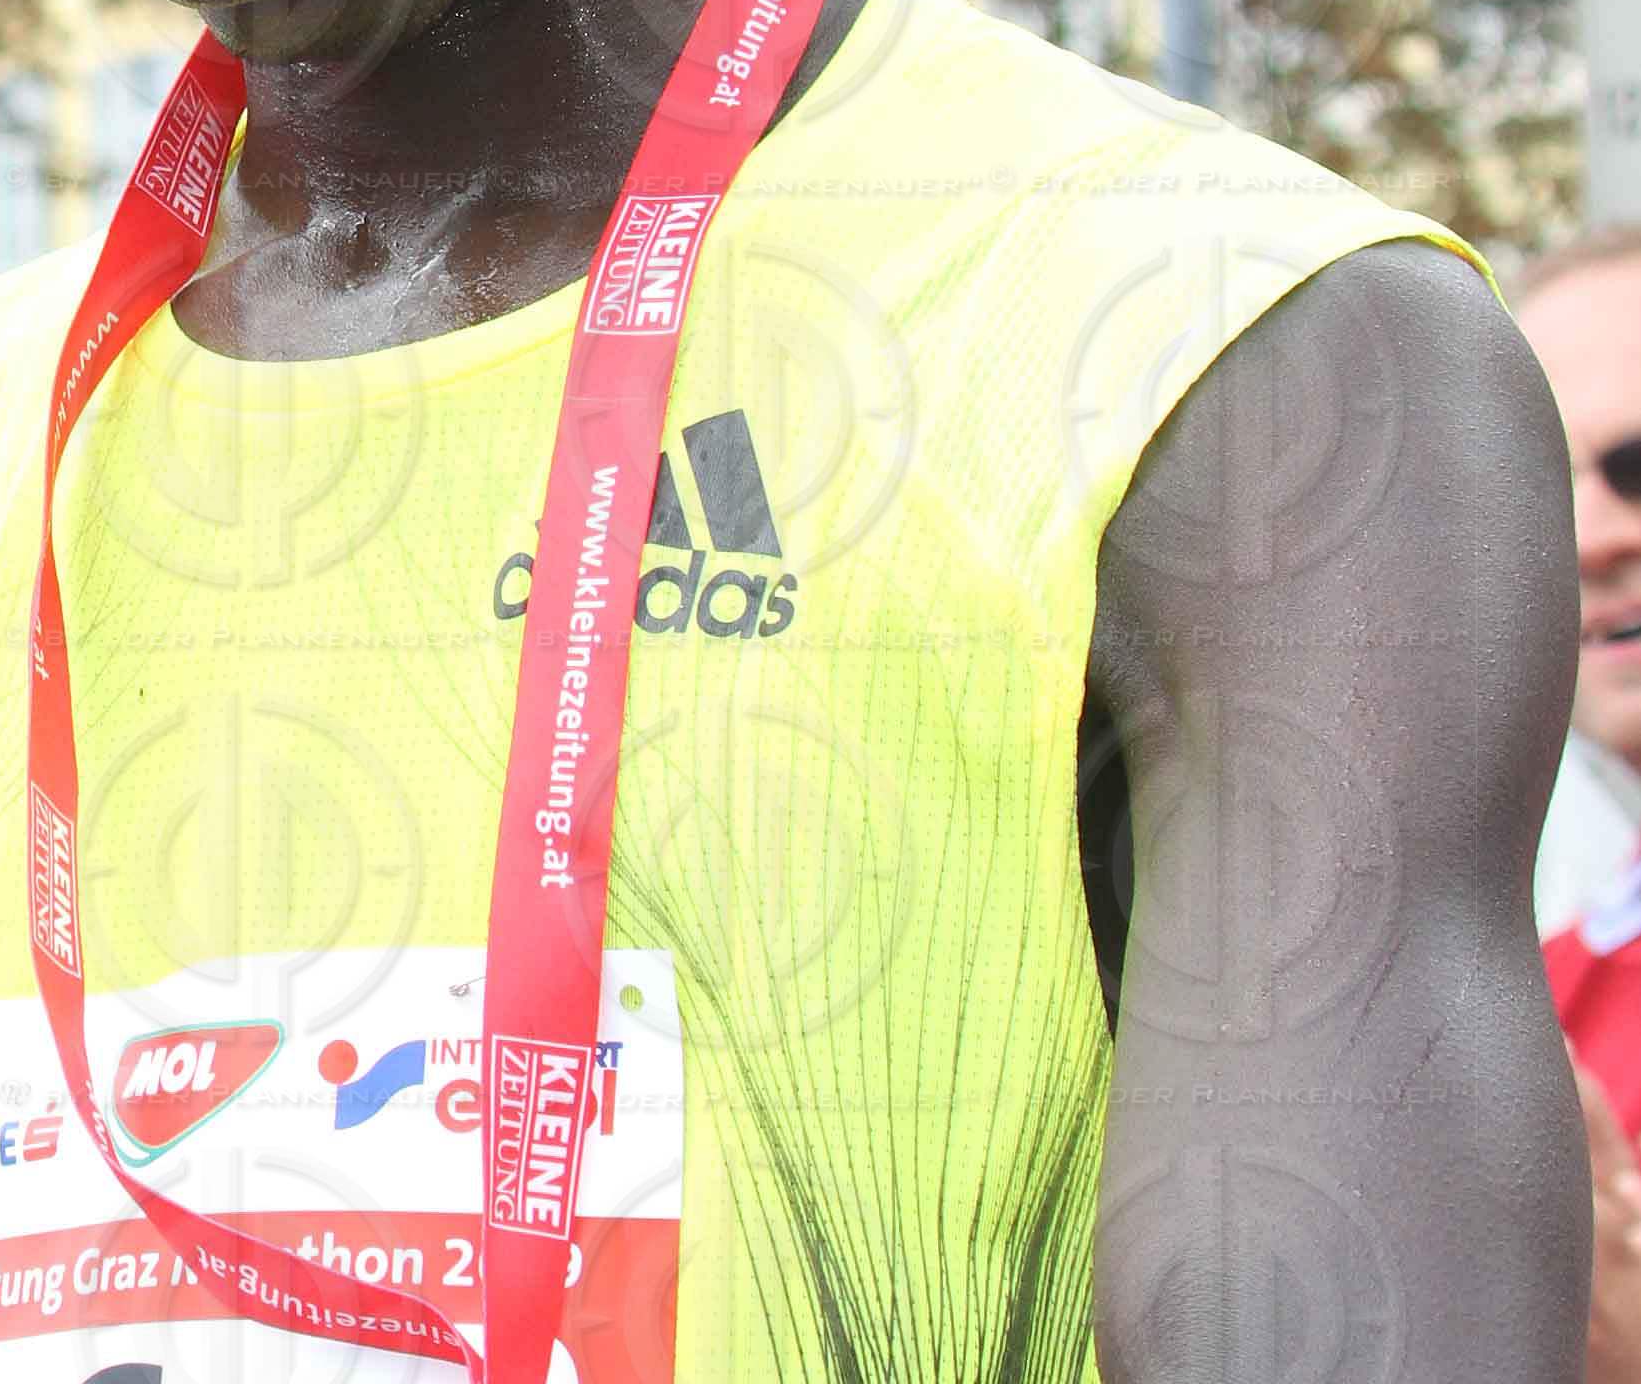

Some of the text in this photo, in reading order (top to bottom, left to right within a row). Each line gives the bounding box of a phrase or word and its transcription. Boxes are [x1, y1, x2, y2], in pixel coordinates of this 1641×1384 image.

[143, 83, 201, 195] ZEITUNG
[172, 111, 223, 225] KLEINE
[597, 203, 660, 327] ZEITUNG
[635, 201, 706, 327] KLEINE
[493, 549, 798, 640] adas
[536, 465, 619, 890] www.kleinezeitung.at
[35, 795, 50, 946] ZEITUNG
[52, 814, 73, 967] KLEINE
[122, 1041, 216, 1098] MOL
[493, 1046, 530, 1221] ZEITUNG
[525, 1053, 580, 1227] KLEINE
[73, 1247, 159, 1293] Graz
